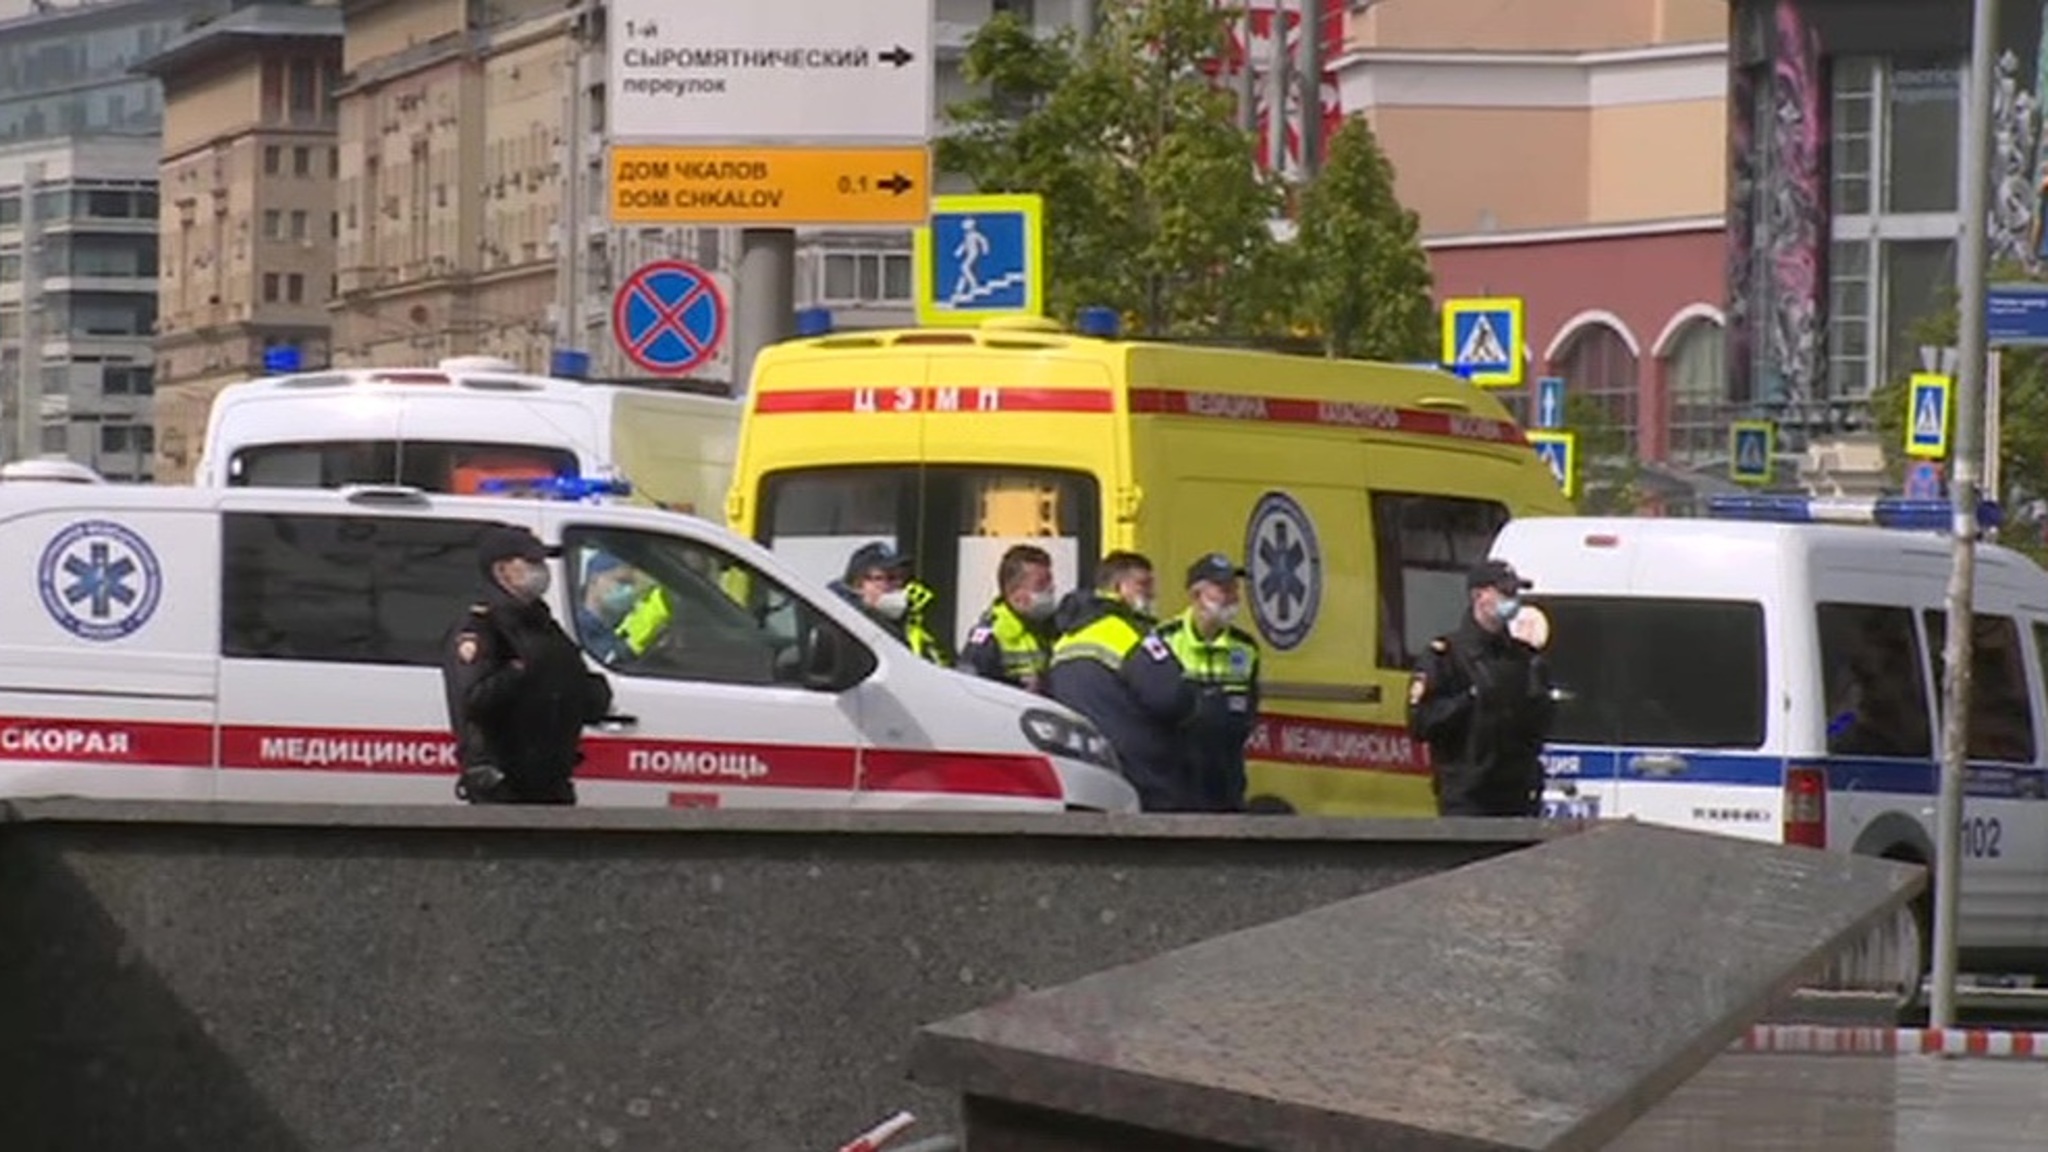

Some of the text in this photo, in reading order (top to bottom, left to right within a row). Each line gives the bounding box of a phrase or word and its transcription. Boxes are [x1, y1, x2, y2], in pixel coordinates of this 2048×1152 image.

[624, 20, 658, 38] 1-й
[623, 47, 870, 69] СЫРОМЯТНИЧЕСКИЙ
[623, 76, 726, 96] переулок
[618, 162, 768, 182] ДОМ ЧКАЛОВ
[618, 190, 783, 208] DOM CHKALOV
[0, 729, 769, 779] СКОРАЯ МЕДИЦИНСК ПОМОЩЬ
[1537, 754, 1581, 776] ЦИЯ
[1960, 816, 2002, 859] 102
